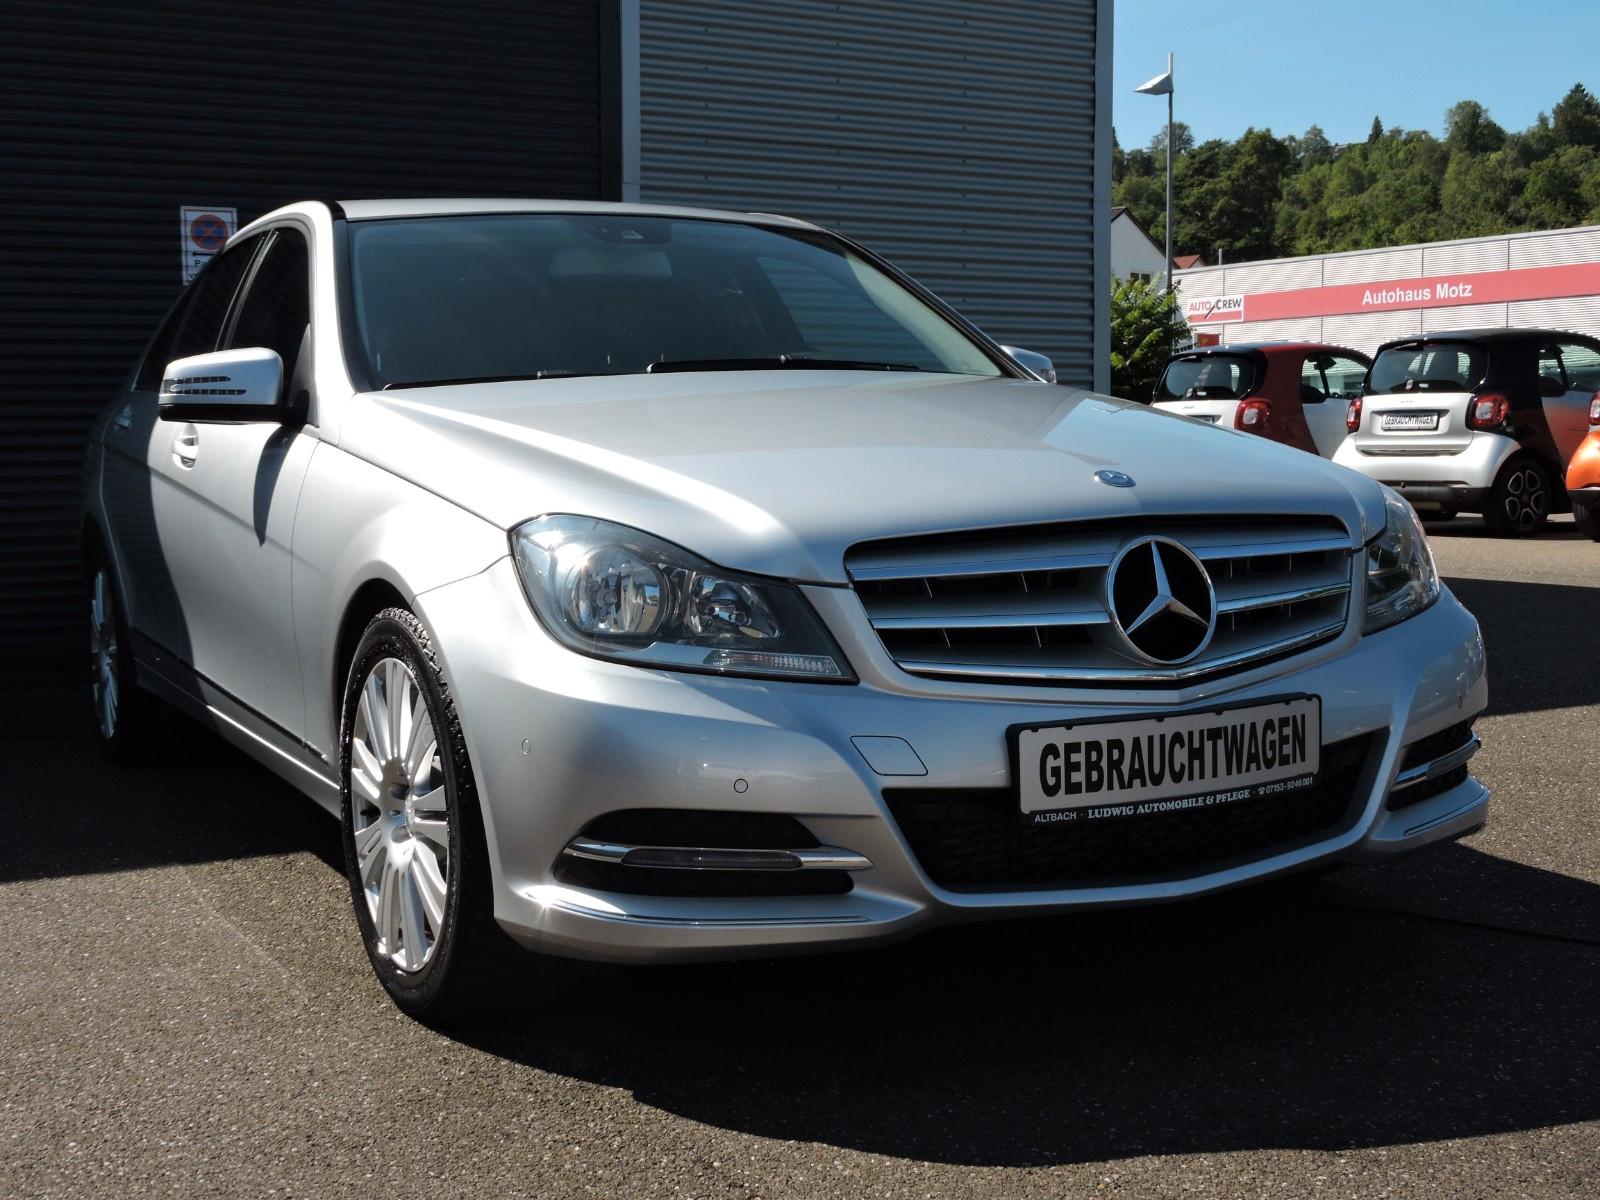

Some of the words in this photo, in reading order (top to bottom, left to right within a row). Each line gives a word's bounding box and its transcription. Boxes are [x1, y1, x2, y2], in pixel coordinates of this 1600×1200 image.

[1189, 301, 1211, 312] AUTO
[1215, 299, 1242, 310] CREW
[1361, 288, 1431, 306] Autohaus
[1436, 282, 1473, 299] Motz
[1039, 713, 1306, 798] GEBRAUCHTWAGEN
[1034, 811, 1077, 823] ALTBACH
[1087, 806, 1134, 819] LUDWIG
[1136, 798, 1205, 814] AUTOMOBILE
[1206, 795, 1215, 805] &
[1215, 789, 1250, 804] PFLEGE
